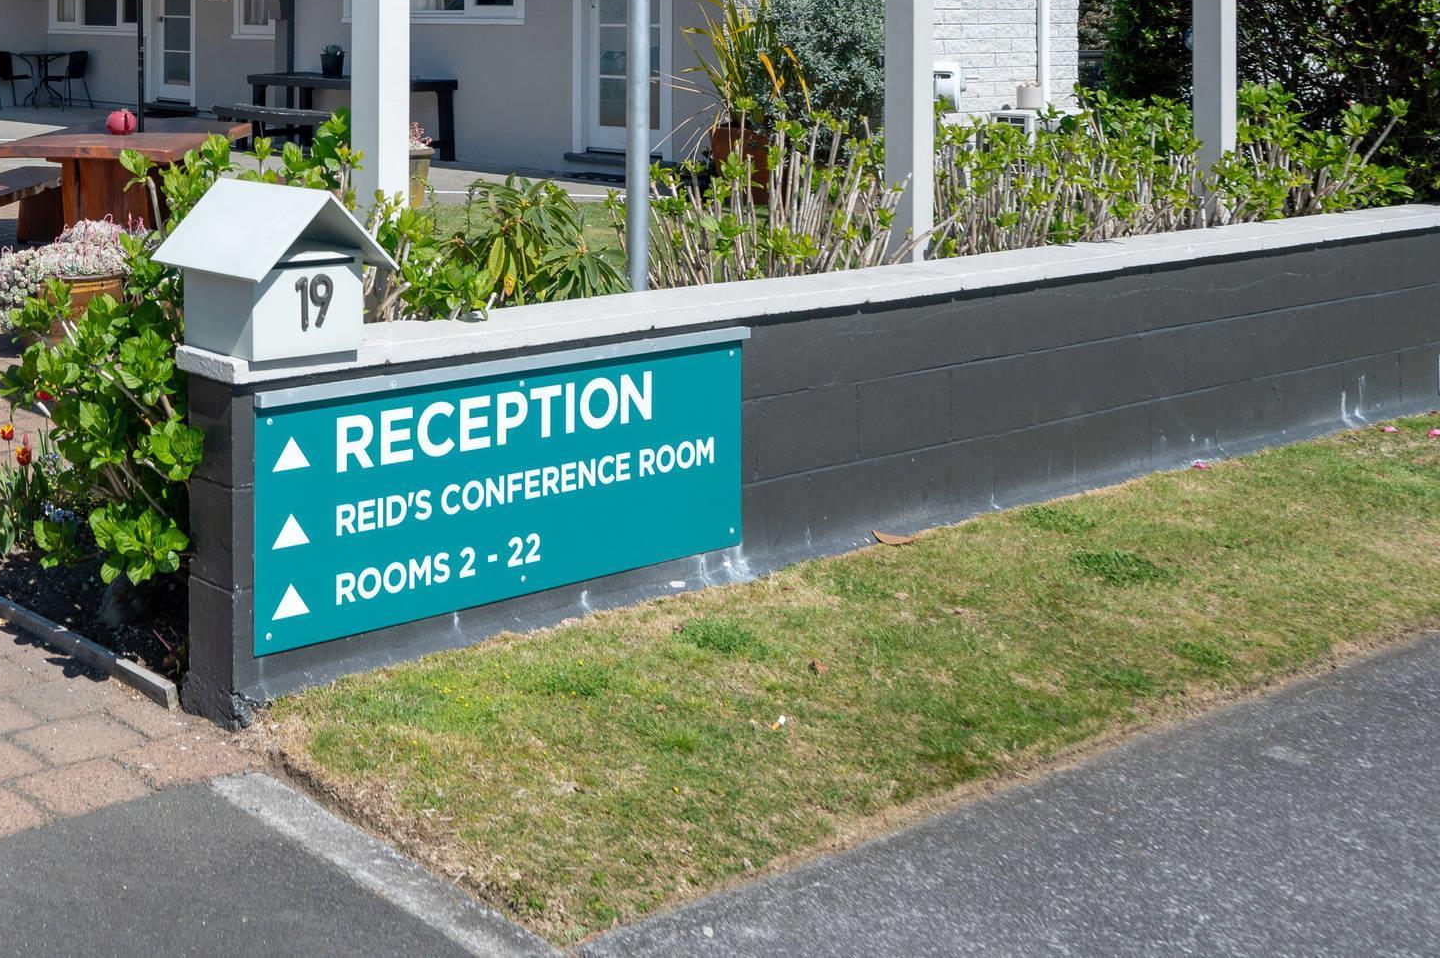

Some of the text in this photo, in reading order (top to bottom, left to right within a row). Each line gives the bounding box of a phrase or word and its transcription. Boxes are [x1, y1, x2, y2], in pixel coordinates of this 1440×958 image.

[294, 273, 334, 332] 19
[336, 370, 654, 473] RECEPTION
[335, 436, 716, 537] REID'S CONFERENCE ROOM
[335, 552, 452, 605] ROOMS
[459, 546, 476, 579] 2
[507, 532, 542, 568] 22
